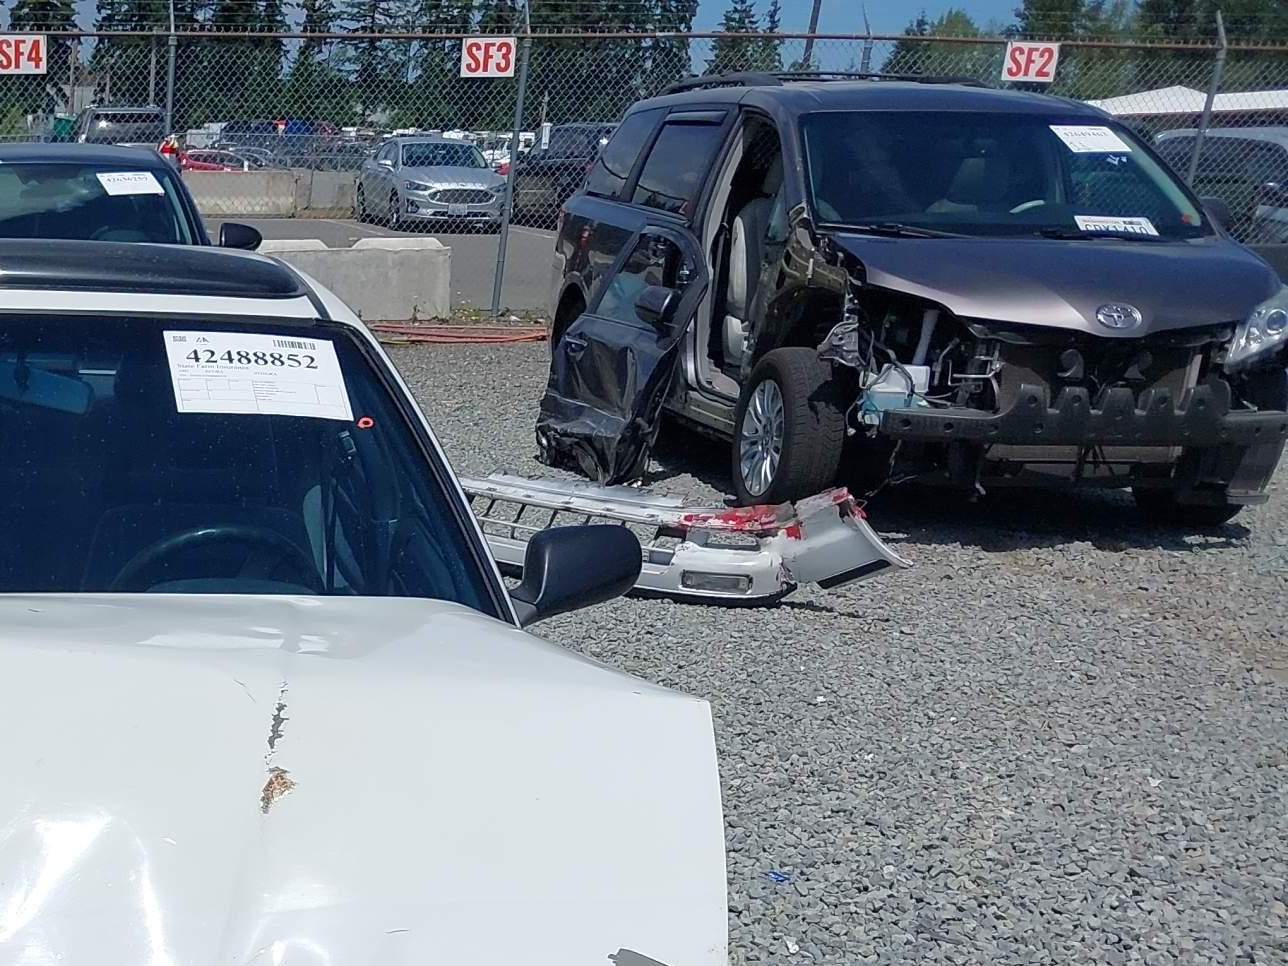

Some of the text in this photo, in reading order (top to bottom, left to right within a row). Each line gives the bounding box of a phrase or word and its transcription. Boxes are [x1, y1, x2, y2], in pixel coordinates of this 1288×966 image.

[465, 42, 512, 73] SF3
[1007, 46, 1054, 77] SF2
[186, 349, 318, 370] 42488852
